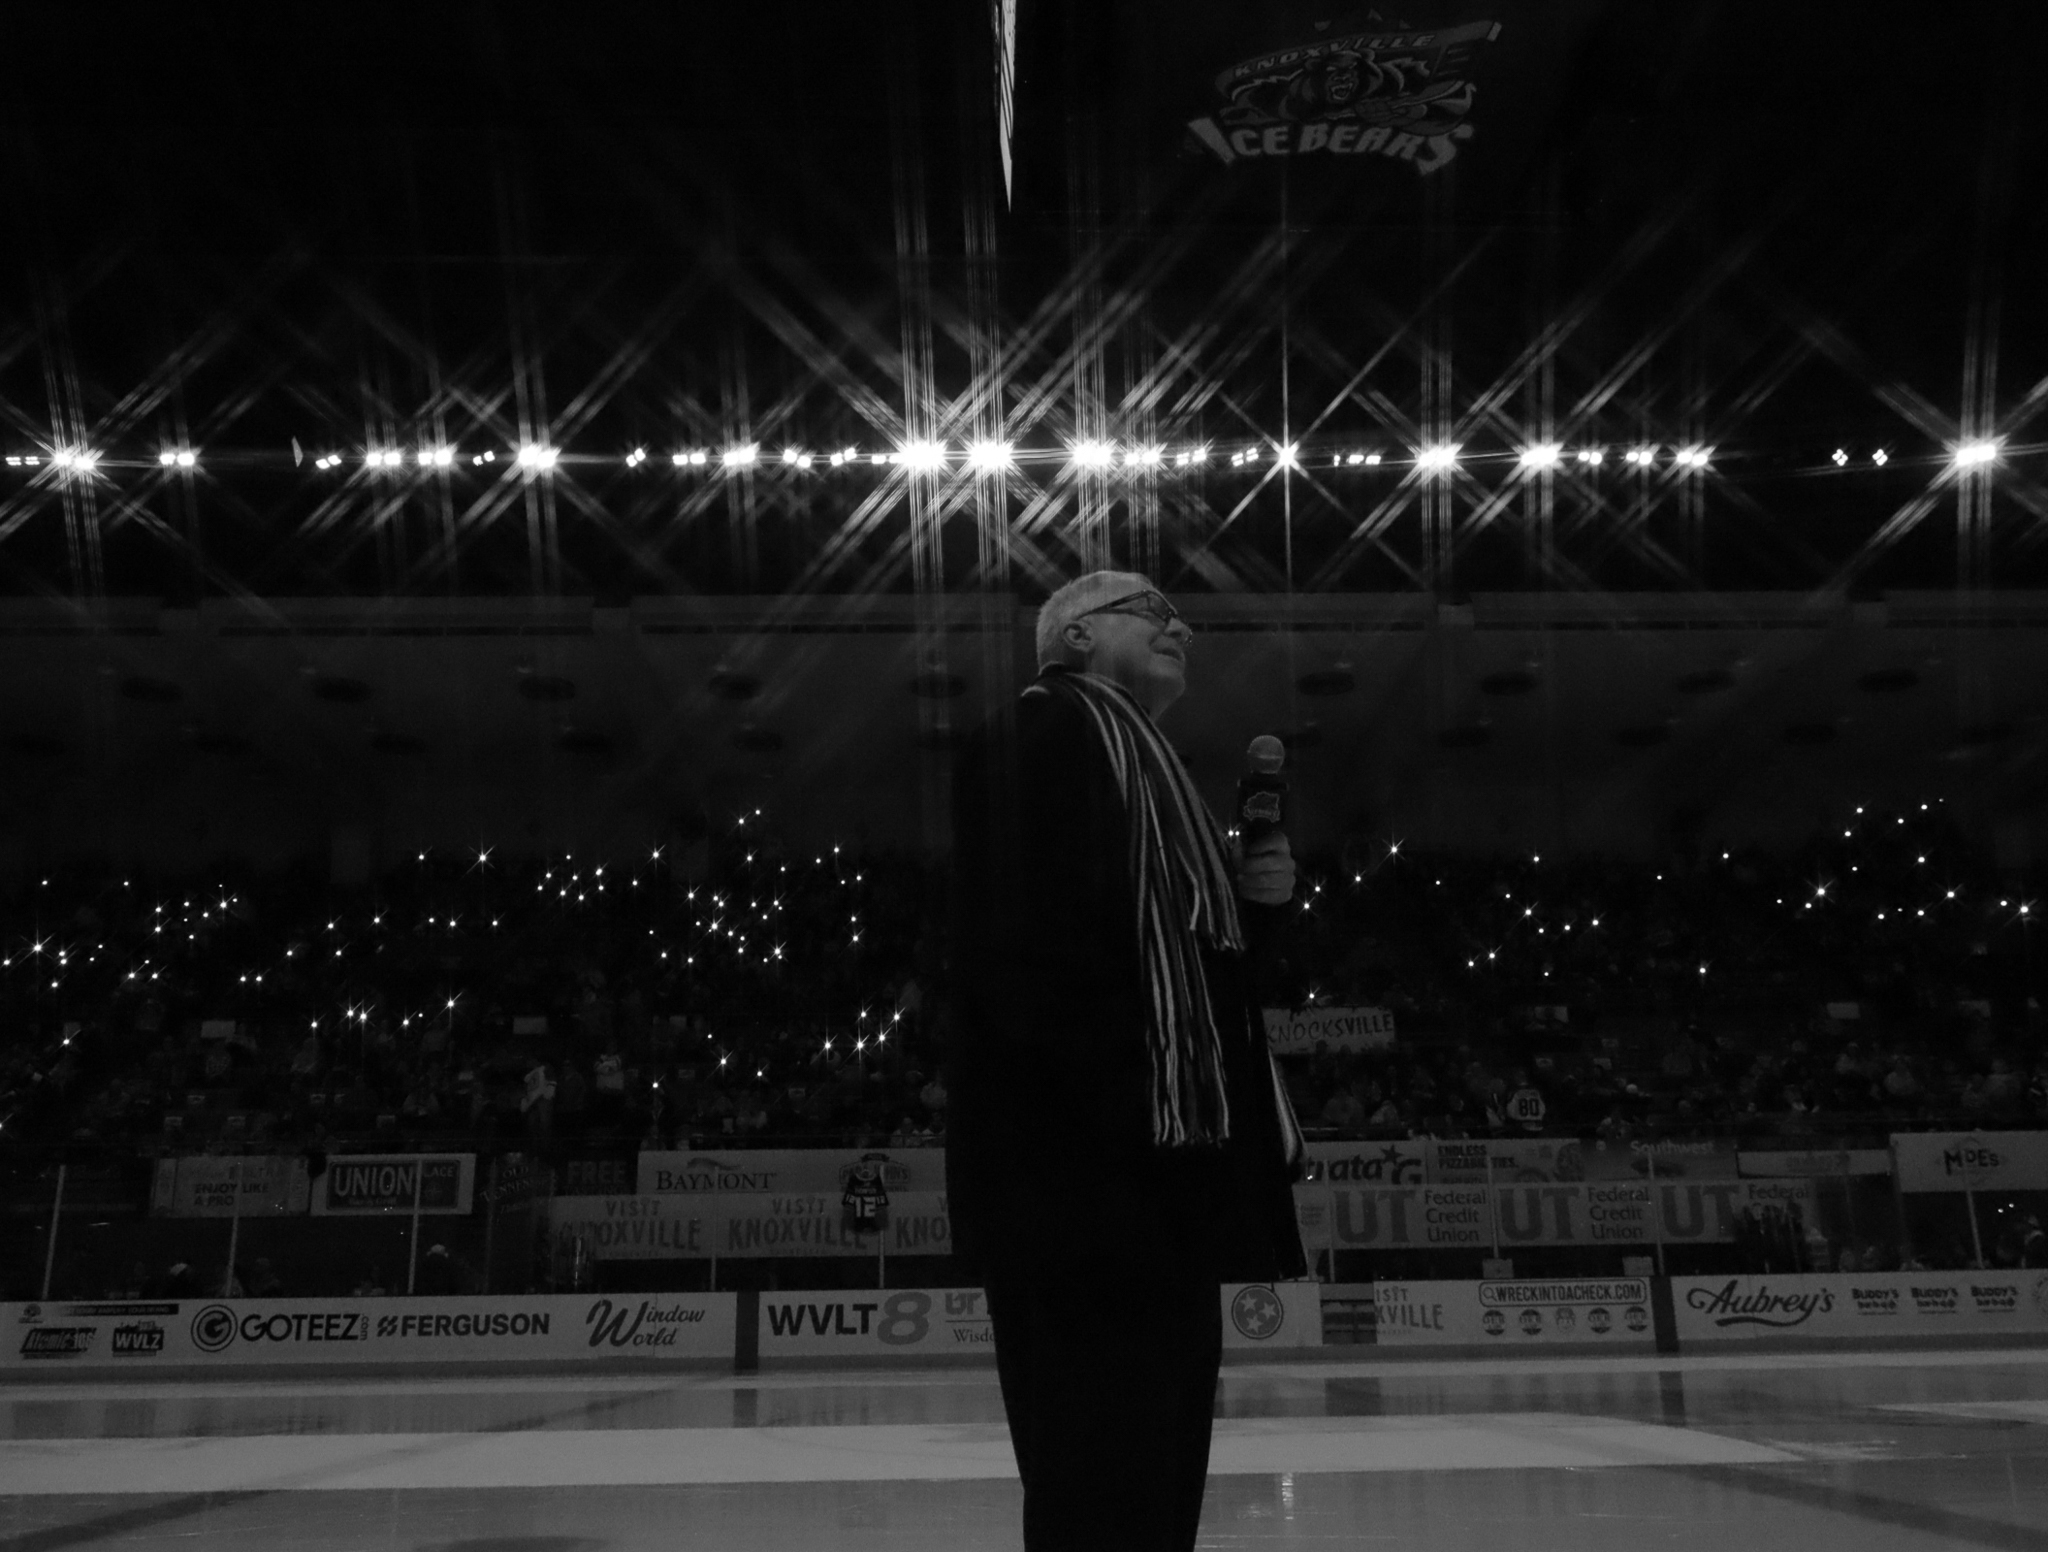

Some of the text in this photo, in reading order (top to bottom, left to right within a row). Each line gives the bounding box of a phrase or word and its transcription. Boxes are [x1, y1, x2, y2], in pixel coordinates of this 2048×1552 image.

[1235, 34, 1436, 79] KNOXVILLE
[1187, 117, 1475, 176] ICE BEARS
[1266, 1013, 1393, 1043] KNOCKSVILLE
[1518, 1098, 1539, 1117] 80
[334, 1165, 414, 1197] UNION
[567, 1160, 627, 1184] FREE
[656, 1170, 777, 1191] BAYMONT
[195, 1182, 269, 1194] ENJOY LIKE
[207, 1195, 235, 1207] PRO
[855, 1196, 876, 1218] 12
[1589, 1205, 1643, 1221] Credit
[1661, 1184, 1741, 1239] UT
[1333, 1189, 1417, 1244] UT
[1424, 1189, 1487, 1205] Federal
[1426, 1207, 1480, 1224] Credit
[1499, 1186, 1649, 1241] UT Federal
[1427, 1227, 1480, 1243] Union
[1591, 1224, 1644, 1240] Union
[1375, 1286, 1409, 1302] ISIT
[1495, 1284, 1642, 1302] WRECKINTOACHECK.COM
[1686, 1279, 1836, 1327] Aubrey's
[240, 1313, 360, 1342] GOTEEZ
[401, 1312, 551, 1338] FERGUSON
[768, 1291, 933, 1346] WVLT 8
[1373, 1303, 1445, 1331] XVILLE
[115, 1332, 162, 1350] WVLZ
